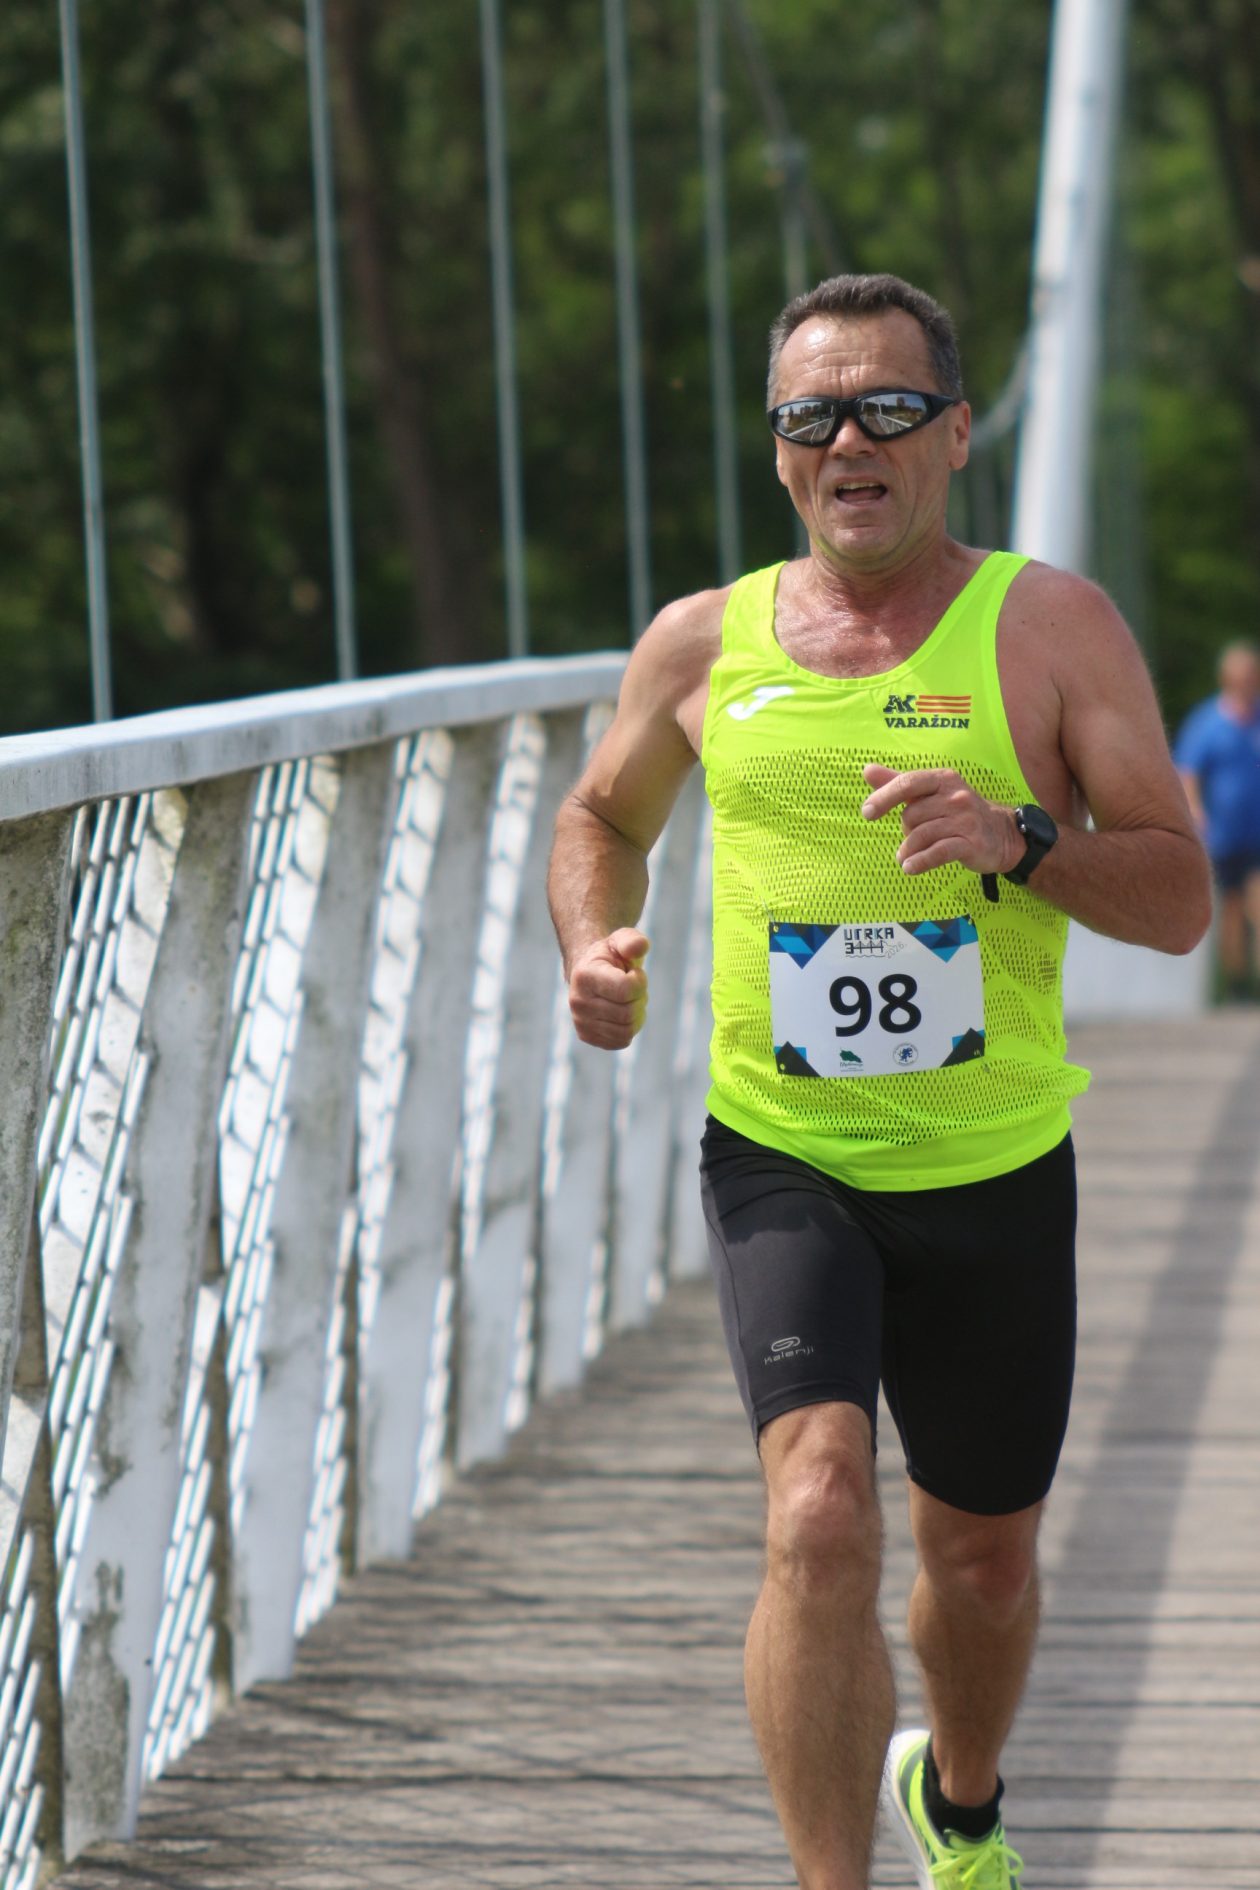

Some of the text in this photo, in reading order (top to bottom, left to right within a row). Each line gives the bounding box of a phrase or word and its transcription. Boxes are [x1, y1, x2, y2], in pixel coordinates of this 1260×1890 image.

[883, 695, 916, 713] AK
[884, 714, 970, 728] VARAŽDIN
[844, 927, 895, 941] UTRKA
[829, 973, 922, 1037] 98
